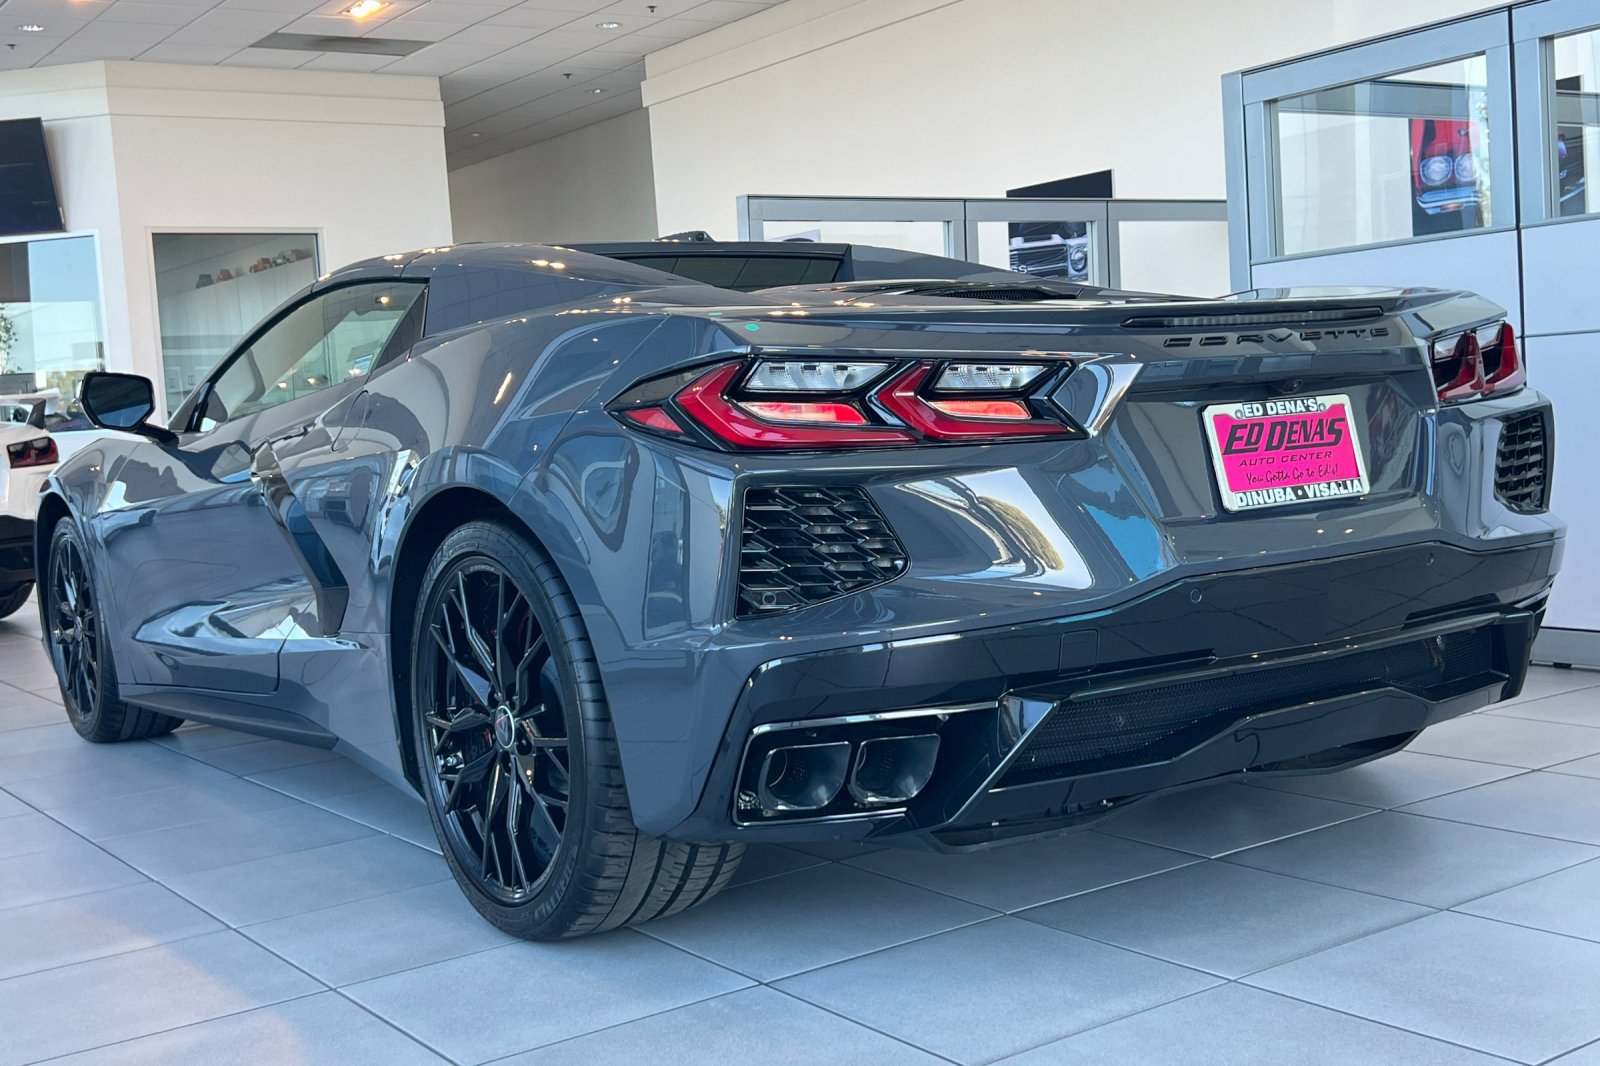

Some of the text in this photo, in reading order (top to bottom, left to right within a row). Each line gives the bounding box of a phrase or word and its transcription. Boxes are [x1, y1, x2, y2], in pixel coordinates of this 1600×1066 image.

[1163, 328, 1390, 347] CORVETTE
[1244, 399, 1318, 418] ED DENA'S
[1222, 418, 1346, 455] ED DENA'S
[1239, 451, 1332, 466] AUTO CENTER
[1246, 472, 1263, 485] You
[1265, 470, 1290, 484] Gotta
[1292, 467, 1304, 481] Go
[1306, 468, 1315, 477] to
[1236, 479, 1364, 507] DINUBA VISALIA
